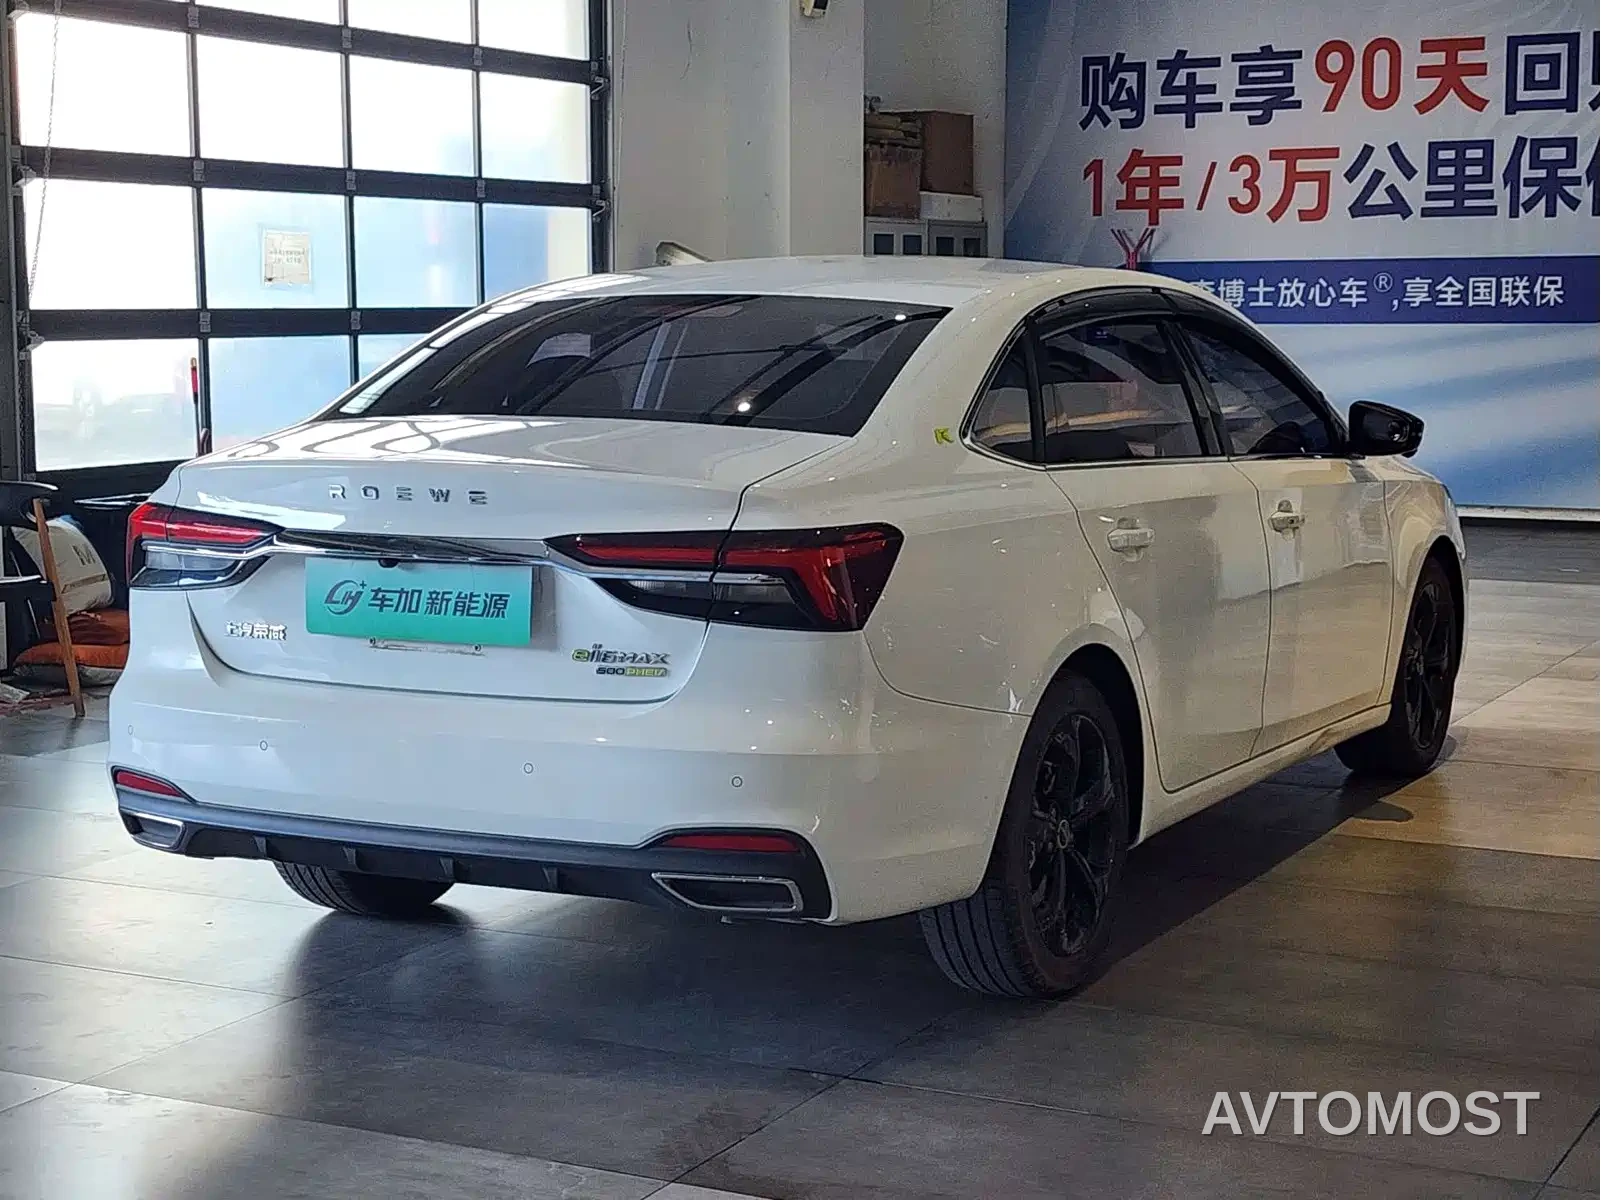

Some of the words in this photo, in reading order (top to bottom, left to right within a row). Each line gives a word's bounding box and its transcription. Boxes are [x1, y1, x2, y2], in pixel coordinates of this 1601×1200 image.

[1079, 31, 1601, 131] 购车享90天回
[328, 484, 488, 505] ROEWE
[368, 587, 510, 619] 车加新能源
